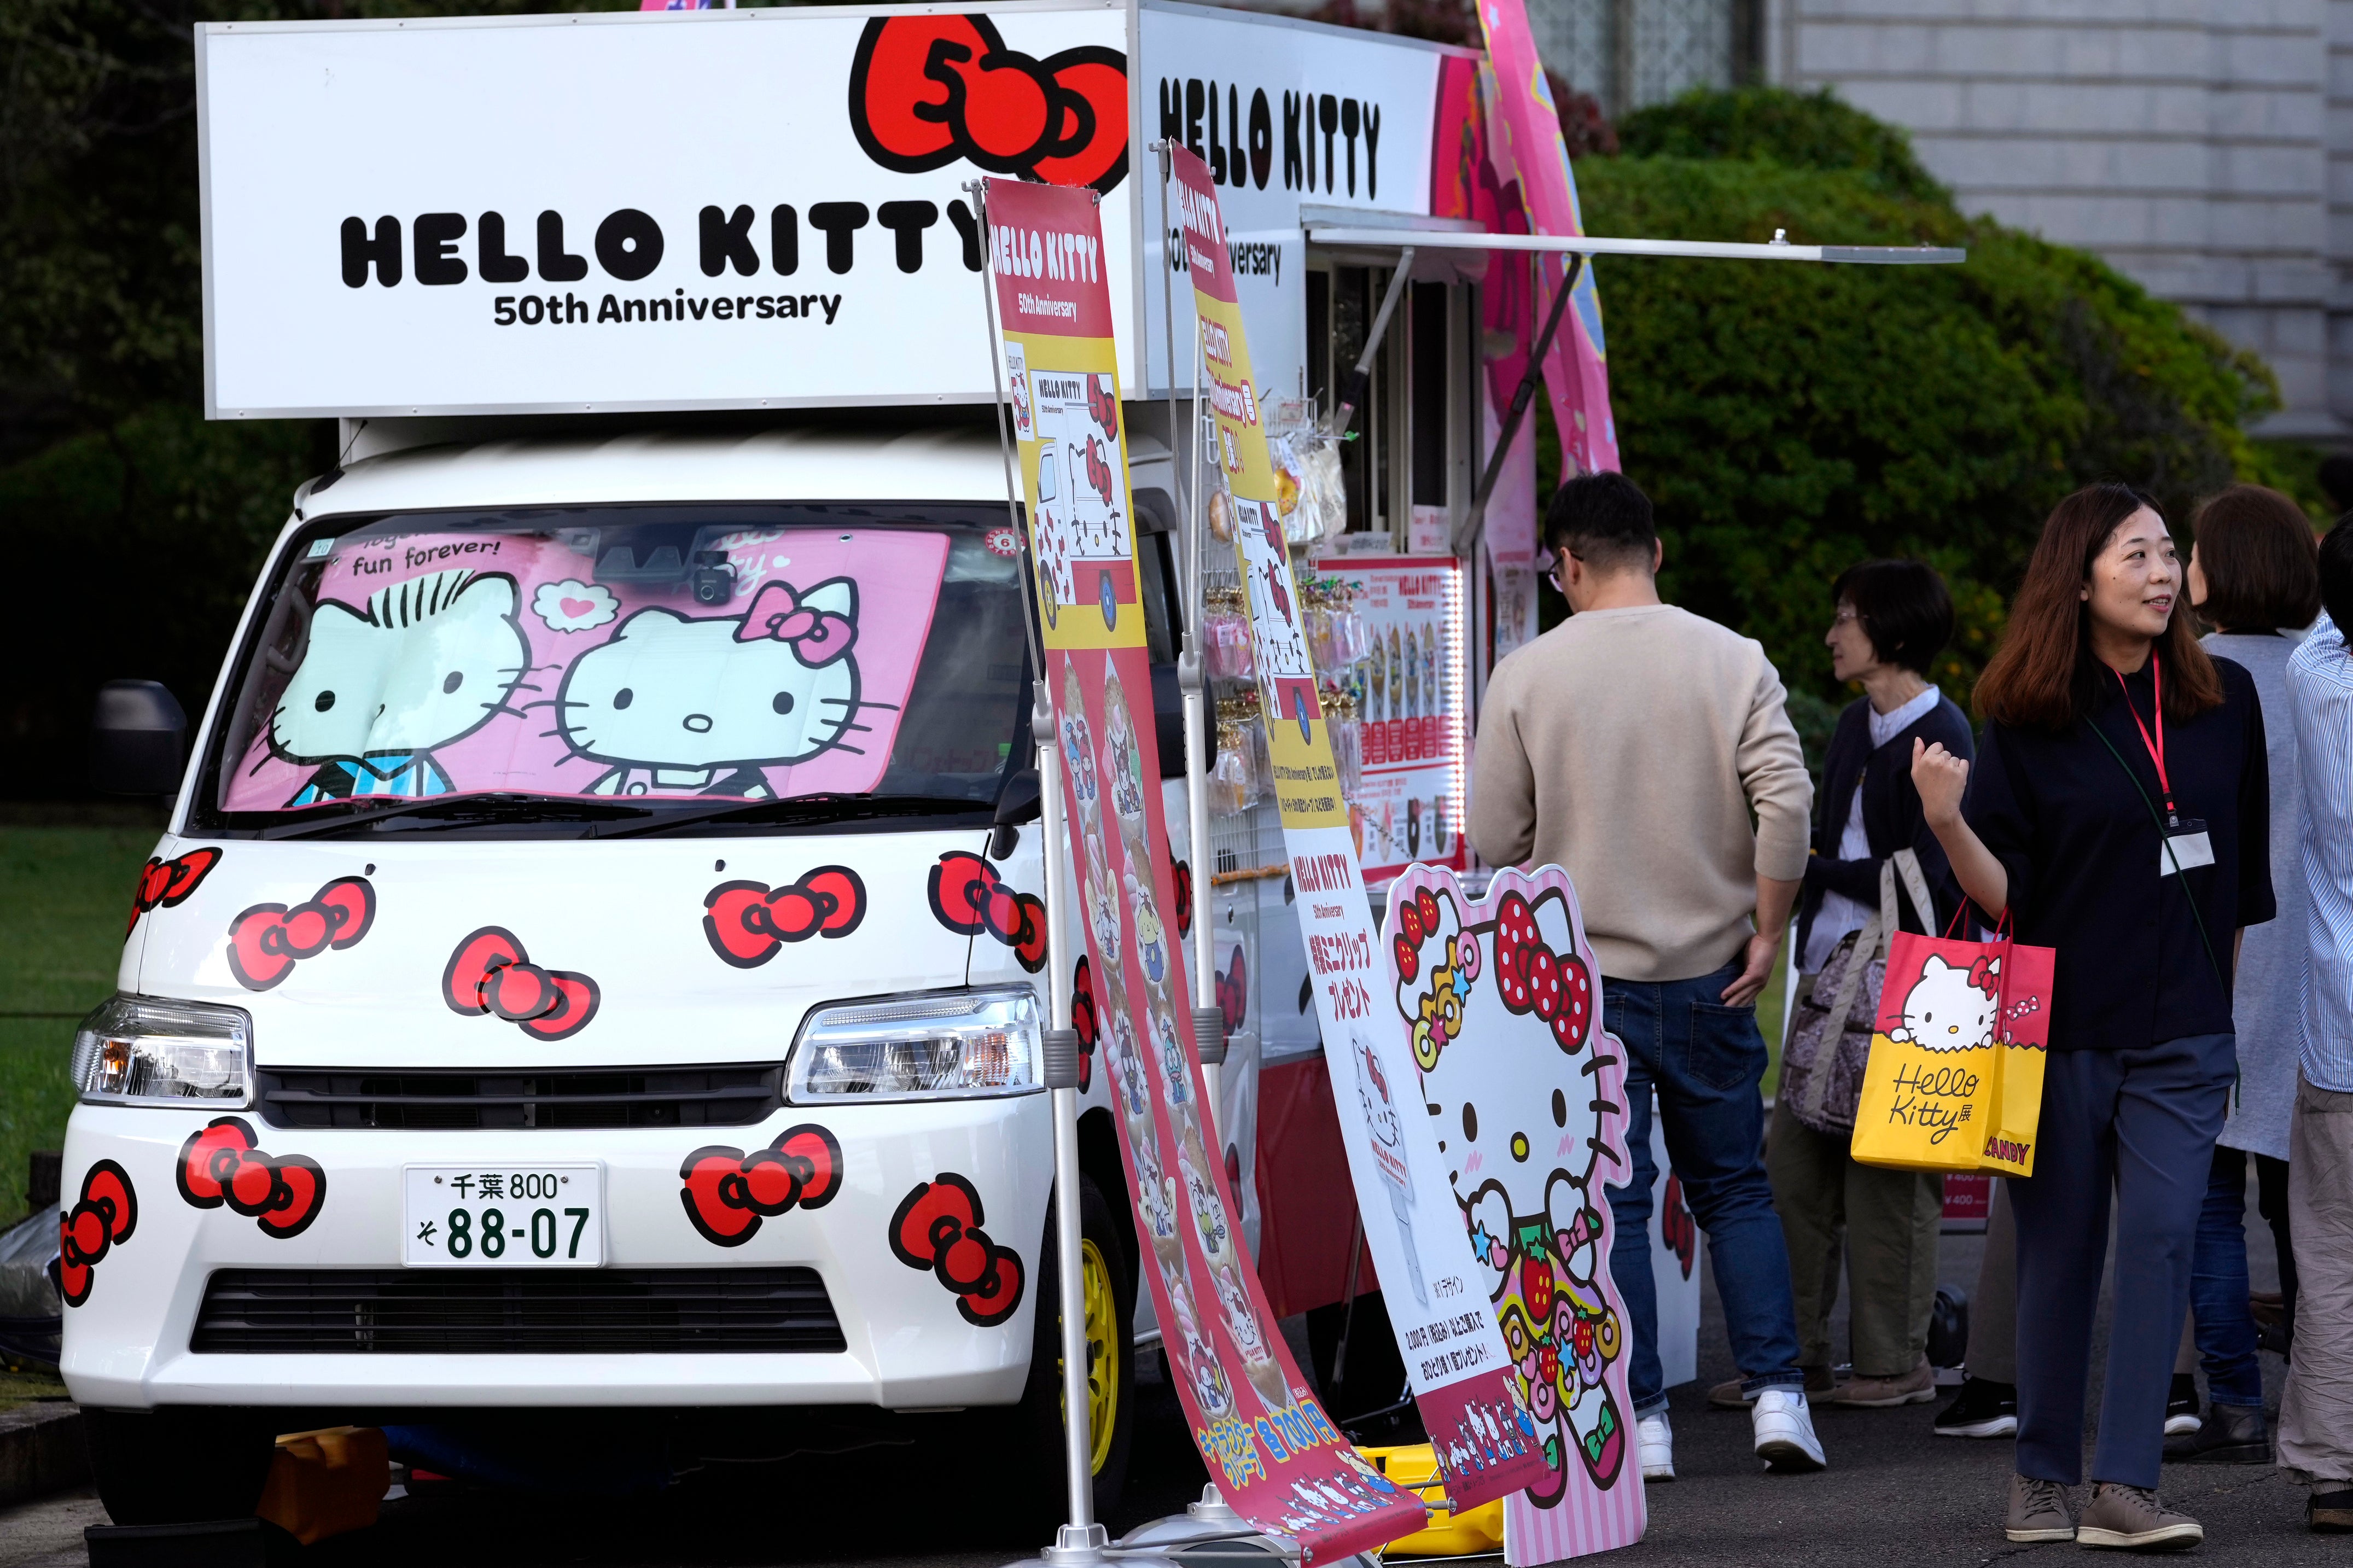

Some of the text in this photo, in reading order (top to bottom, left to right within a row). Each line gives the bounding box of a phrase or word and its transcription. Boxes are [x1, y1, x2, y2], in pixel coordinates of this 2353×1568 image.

[1160, 77, 1381, 201] HELLO KITTY
[1195, 190, 1220, 244] KITTY
[341, 200, 990, 289] HELLO KITTY
[990, 223, 1098, 284] HELLO KITTY
[494, 288, 842, 326] 50th Anniversary
[1018, 292, 1077, 323] 50th Anniversary
[1039, 379, 1081, 400] HELLO KITTY
[1047, 405, 1064, 416] Anniversary
[353, 556, 392, 576] fun
[405, 541, 500, 569] forever!
[1001, 539, 1010, 547] 6
[1294, 854, 1352, 893] HELLO KITTY
[1313, 902, 1344, 920] 50th Anniversary
[1309, 928, 1371, 976] 特製ミニクリップ
[1329, 977, 1371, 1022] プレゼント
[1893, 1063, 1980, 1098] Hello
[1371, 1138, 1407, 1178] HELLO KITTY
[1983, 1136, 2031, 1166] CANDY
[451, 1174, 557, 1199] 千葉 800
[417, 1208, 590, 1258] そ 88-07
[1197, 1415, 1256, 1464] キャラクター
[1221, 1450, 1267, 1491] クレープ
